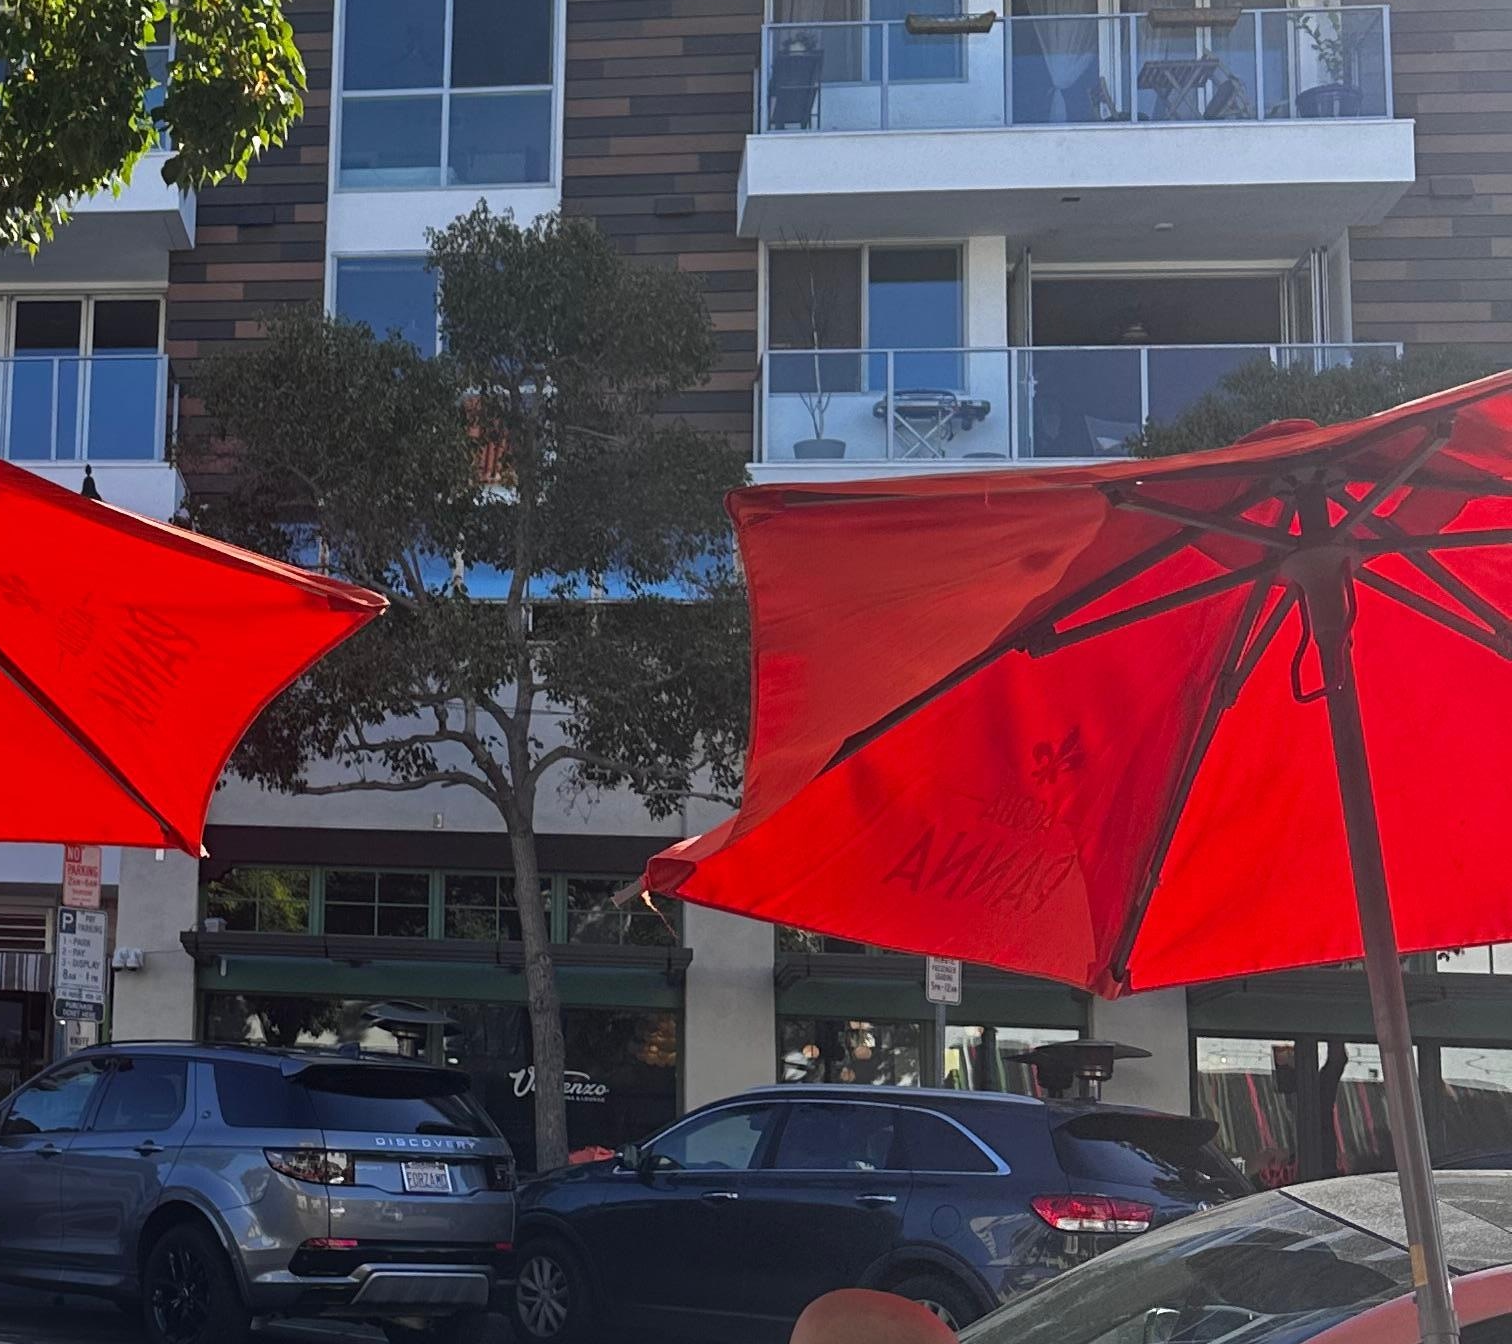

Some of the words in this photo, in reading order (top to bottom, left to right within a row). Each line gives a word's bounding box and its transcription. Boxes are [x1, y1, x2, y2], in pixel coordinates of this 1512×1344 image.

[67, 846, 81, 862] NO
[67, 863, 99, 878] PARKING
[62, 912, 74, 931] P
[508, 1065, 610, 1098] Vienzo
[374, 1136, 476, 1150] DISCOVERY
